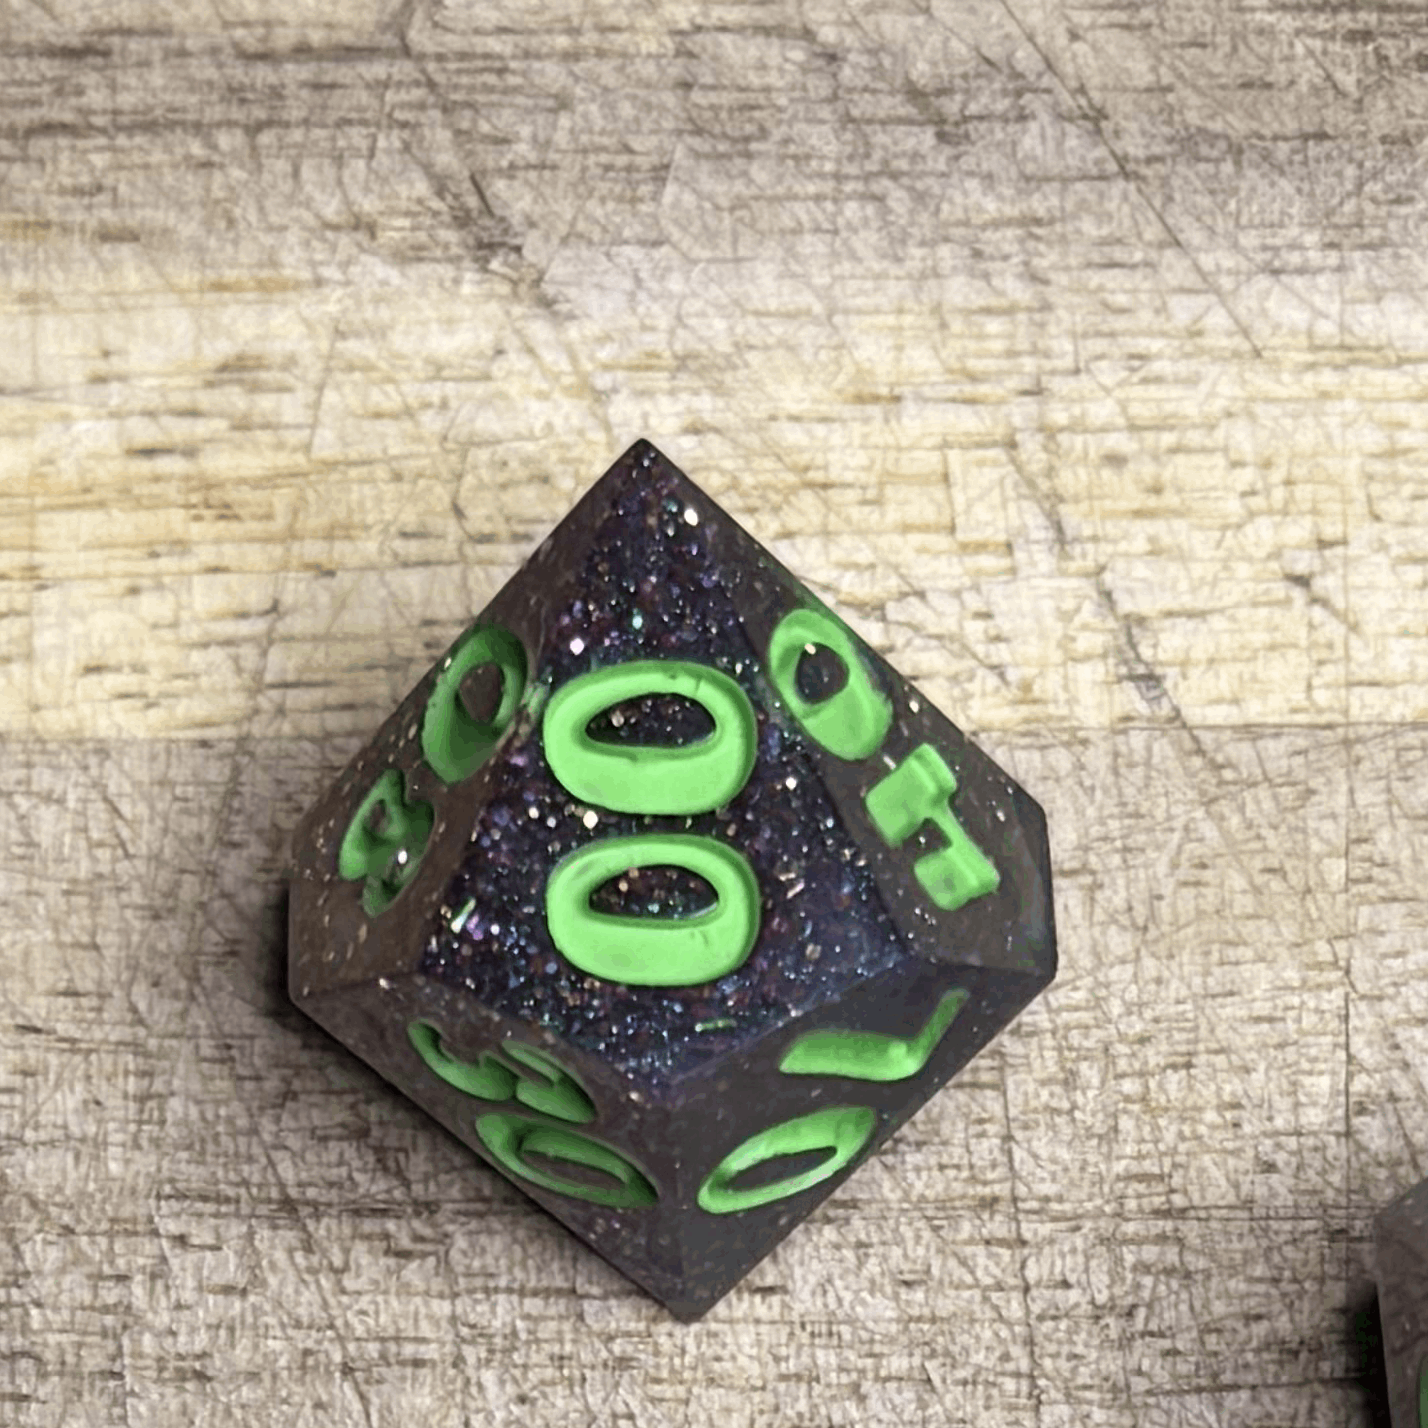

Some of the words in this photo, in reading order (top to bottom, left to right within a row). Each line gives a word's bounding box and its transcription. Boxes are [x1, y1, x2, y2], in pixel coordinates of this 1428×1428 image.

[540, 660, 759, 987] 00
[765, 598, 1000, 911] 40
[408, 1018, 660, 1210] 30
